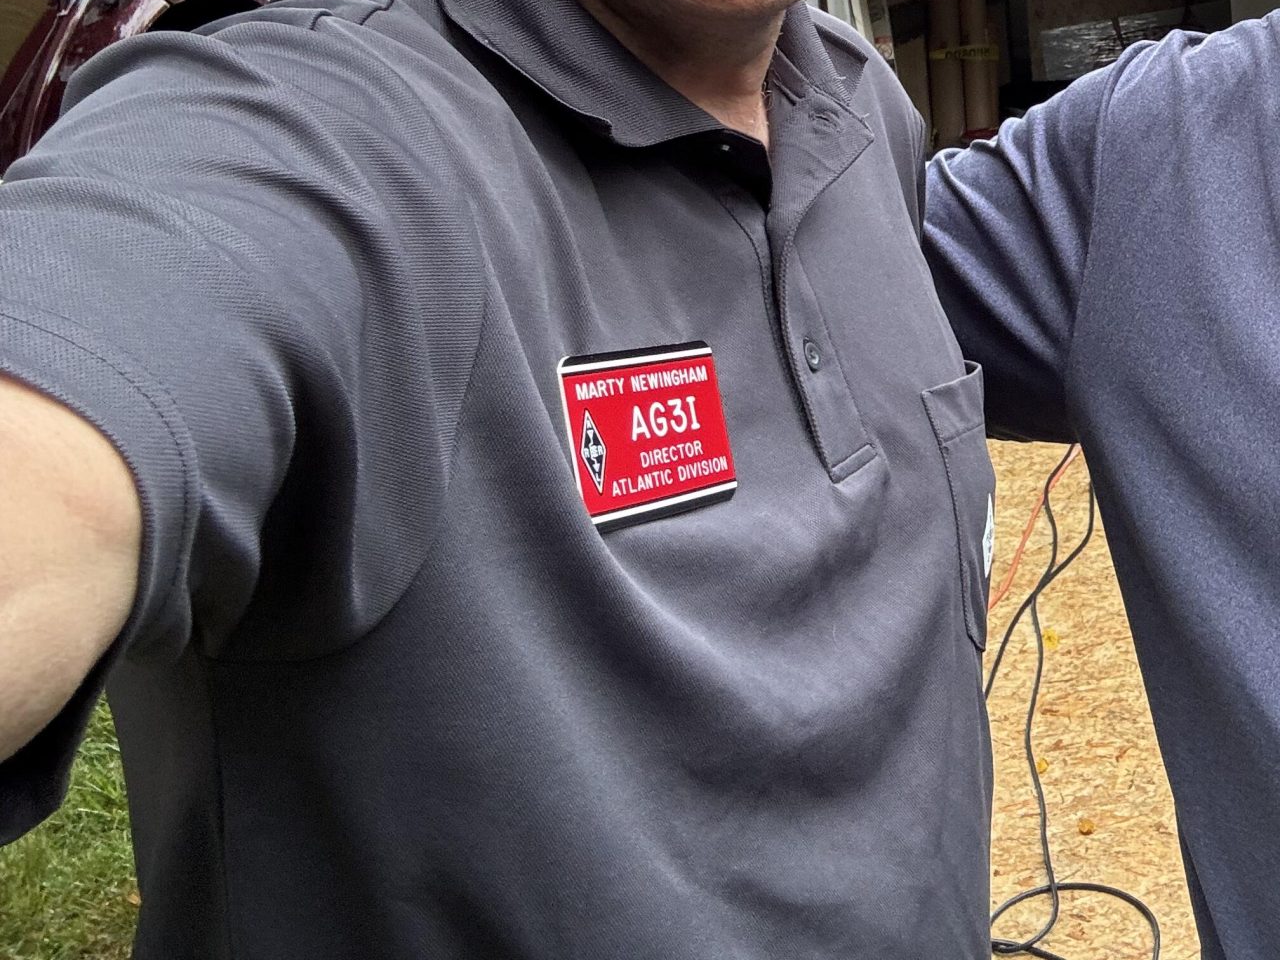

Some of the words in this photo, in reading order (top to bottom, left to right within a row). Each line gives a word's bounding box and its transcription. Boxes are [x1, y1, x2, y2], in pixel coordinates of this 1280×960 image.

[575, 377, 625, 401] MARTY
[630, 365, 708, 393] NEWINGHAM
[631, 396, 701, 442] AG3I
[640, 440, 704, 469] DIRECTOR
[612, 469, 674, 497] ATLANTIC
[678, 455, 728, 480] DIVISION
